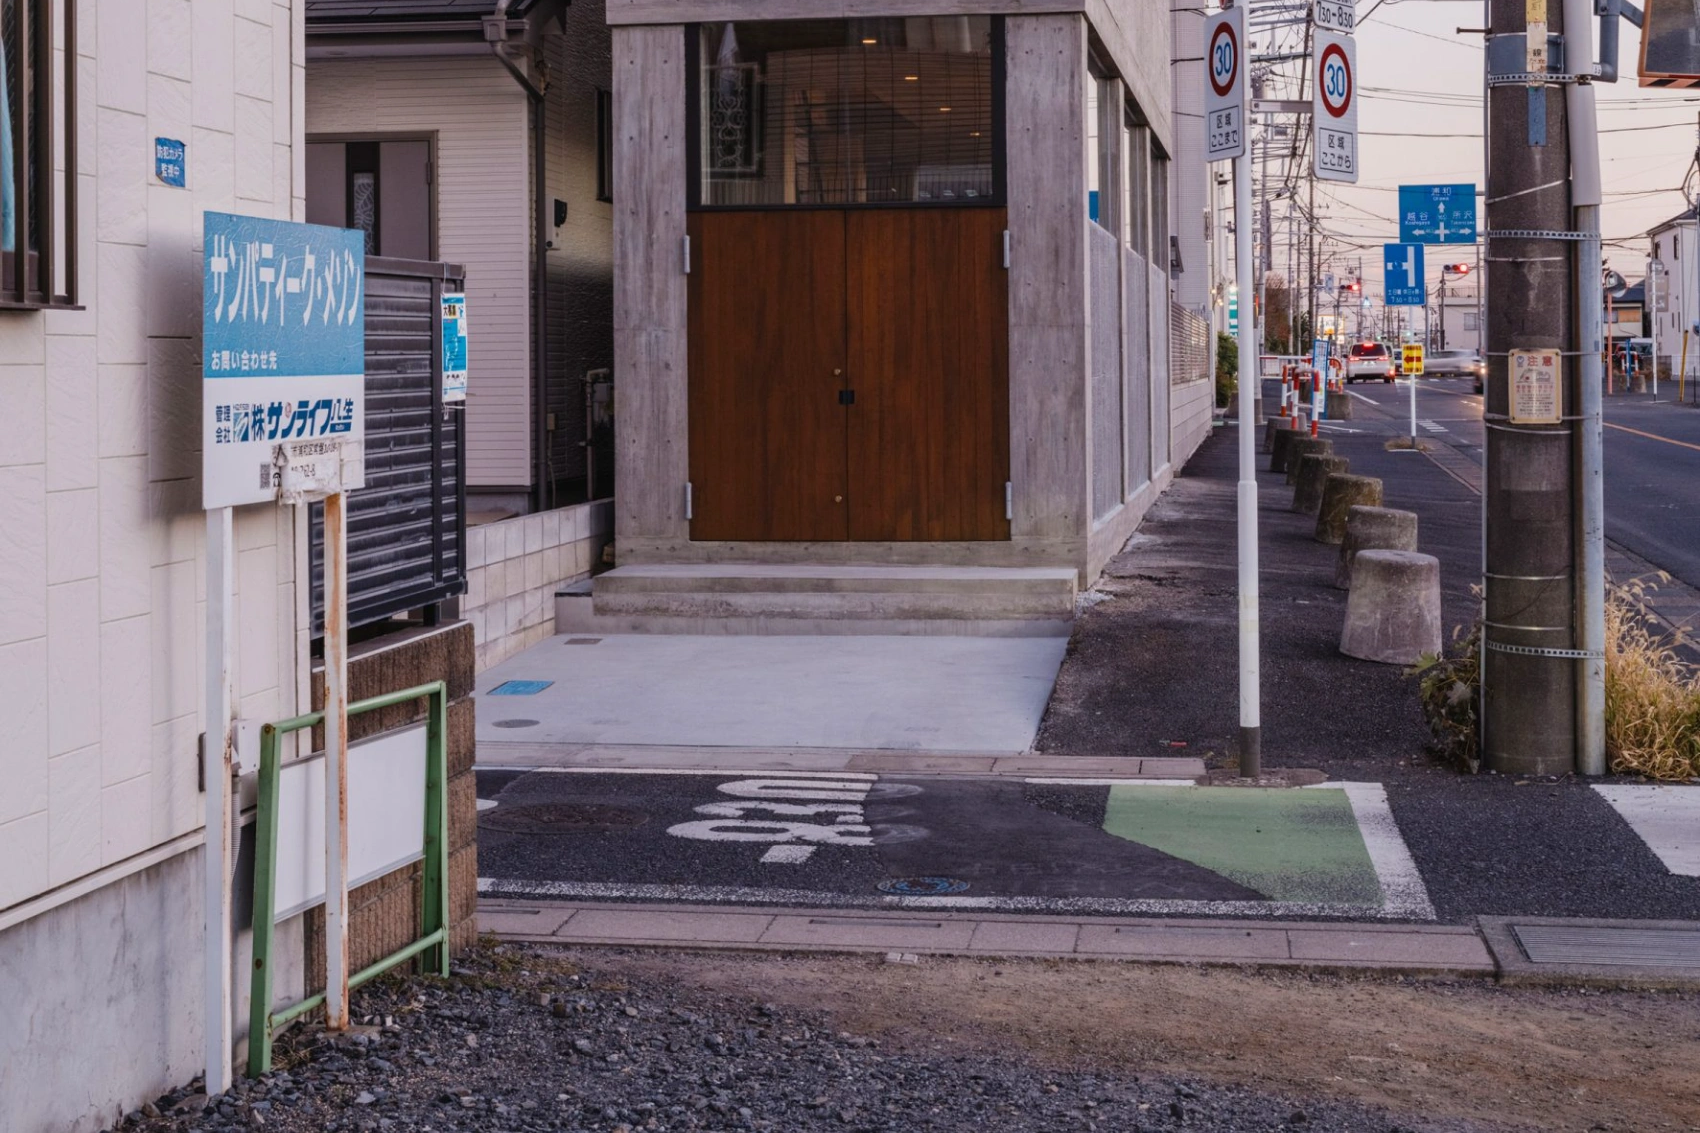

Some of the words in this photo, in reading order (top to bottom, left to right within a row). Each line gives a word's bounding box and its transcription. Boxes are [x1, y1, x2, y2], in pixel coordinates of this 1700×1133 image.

[1215, 42, 1232, 77] 30
[1327, 63, 1345, 98] 30
[1216, 112, 1232, 129] 区域
[1211, 130, 1238, 147] ここまで
[1328, 134, 1345, 151] 区域
[1322, 151, 1351, 169] ここから
[211, 234, 360, 326] サンパティーク・メゾン
[211, 349, 277, 371] お問い合わせ先
[1527, 355, 1553, 367] 注意
[215, 405, 231, 423] 管理
[215, 426, 231, 444] 会社
